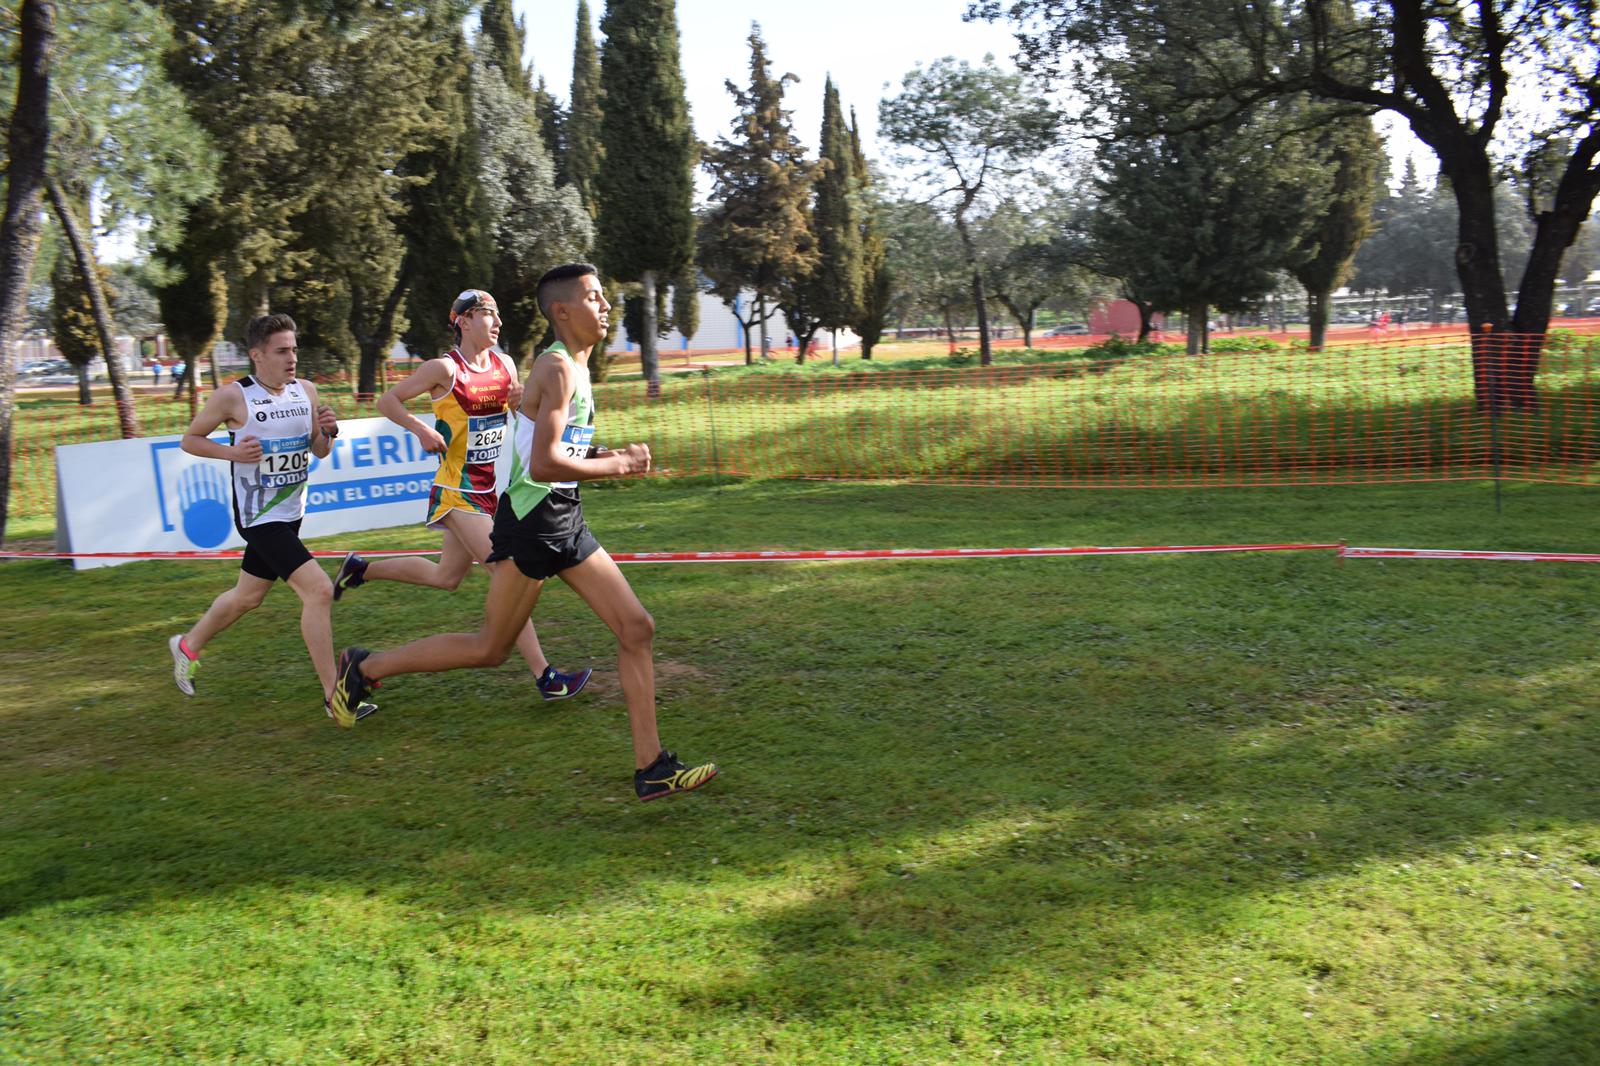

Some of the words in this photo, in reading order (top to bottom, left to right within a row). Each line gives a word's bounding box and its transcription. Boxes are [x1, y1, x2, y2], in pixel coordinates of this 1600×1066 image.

[474, 430, 503, 447] 2624
[265, 450, 309, 473] 1209
[305, 489, 339, 506] ON
[343, 486, 367, 501] EL
